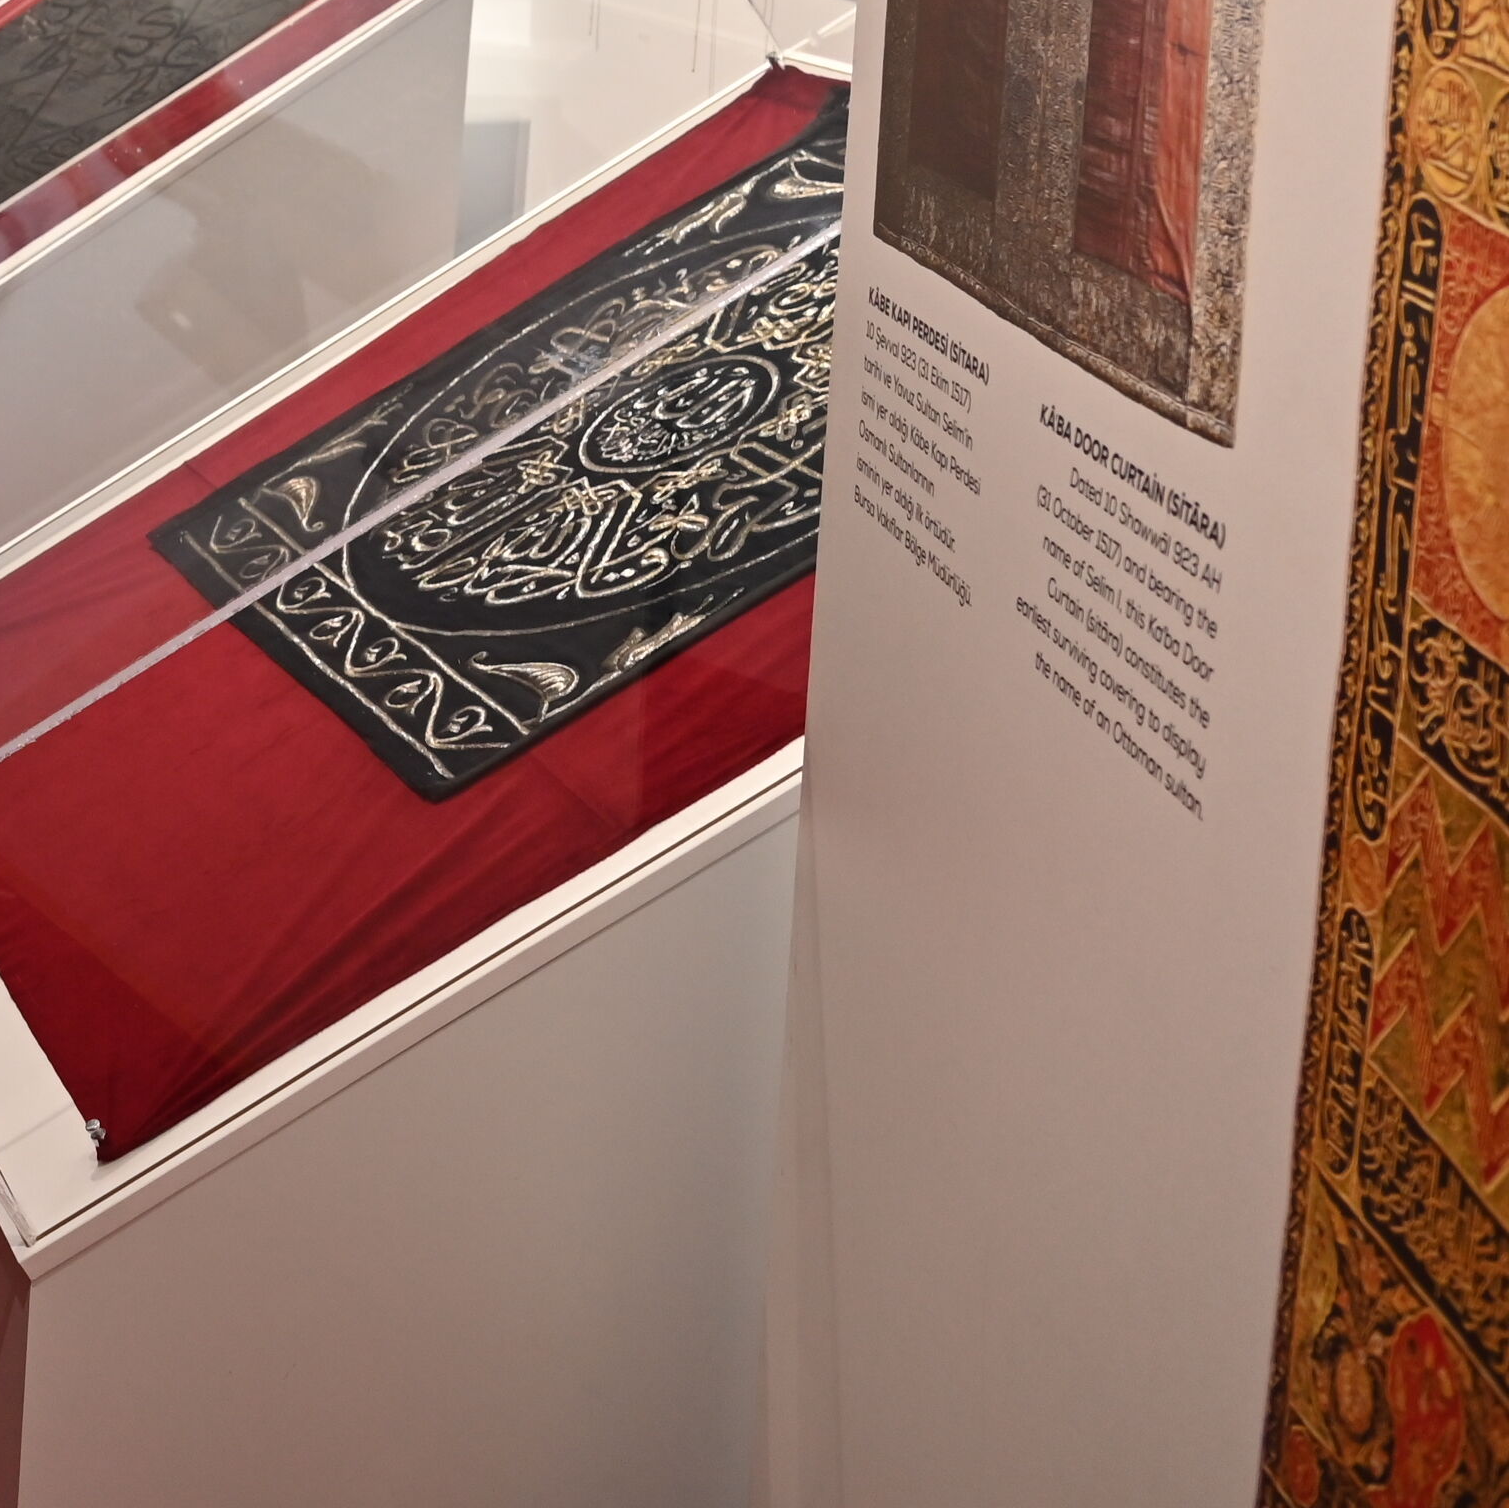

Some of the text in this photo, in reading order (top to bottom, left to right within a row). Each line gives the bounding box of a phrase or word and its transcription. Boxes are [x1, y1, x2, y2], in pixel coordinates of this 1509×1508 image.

[866, 320, 972, 414] 10 Şevval 923 (31 Ekim 1517)
[868, 286, 990, 386] KÂBE KAPI PERDESİ (SİTARA)
[861, 385, 981, 496] ismi yer aldığı Kâbe Kapı Perdesi
[864, 354, 883, 382] tarihi
[883, 370, 892, 389] ve
[893, 373, 915, 407] Yavuz
[916, 391, 941, 427] Sultan
[856, 451, 956, 553] isminin yer aldığı ilk örtüdür.
[859, 419, 935, 497] Osmanlı Sultanlarının
[1074, 426, 1109, 469] DOOR
[1111, 452, 1165, 507] CURTAİN
[854, 484, 875, 518] Bursa
[876, 503, 904, 542] Vakıflar
[905, 529, 927, 566] Bölge
[1037, 483, 1218, 640] (31 October 1517) and bearing the
[1069, 466, 1103, 506] Dated
[1103, 491, 1118, 517] 10
[1172, 540, 1200, 577] 923
[1200, 563, 1222, 594] AH
[1042, 536, 1072, 570] name
[1073, 560, 1086, 580] of
[1085, 564, 1116, 605] Selim
[1125, 598, 1146, 630] this
[1182, 641, 1215, 682] Door
[1047, 576, 1085, 623] Curtain
[1124, 646, 1187, 710] constitutes
[1188, 695, 1211, 730] the
[1016, 596, 1207, 780] earliest surviving covering to display
[1035, 650, 1204, 822] the name of an Ottoman sultan.
